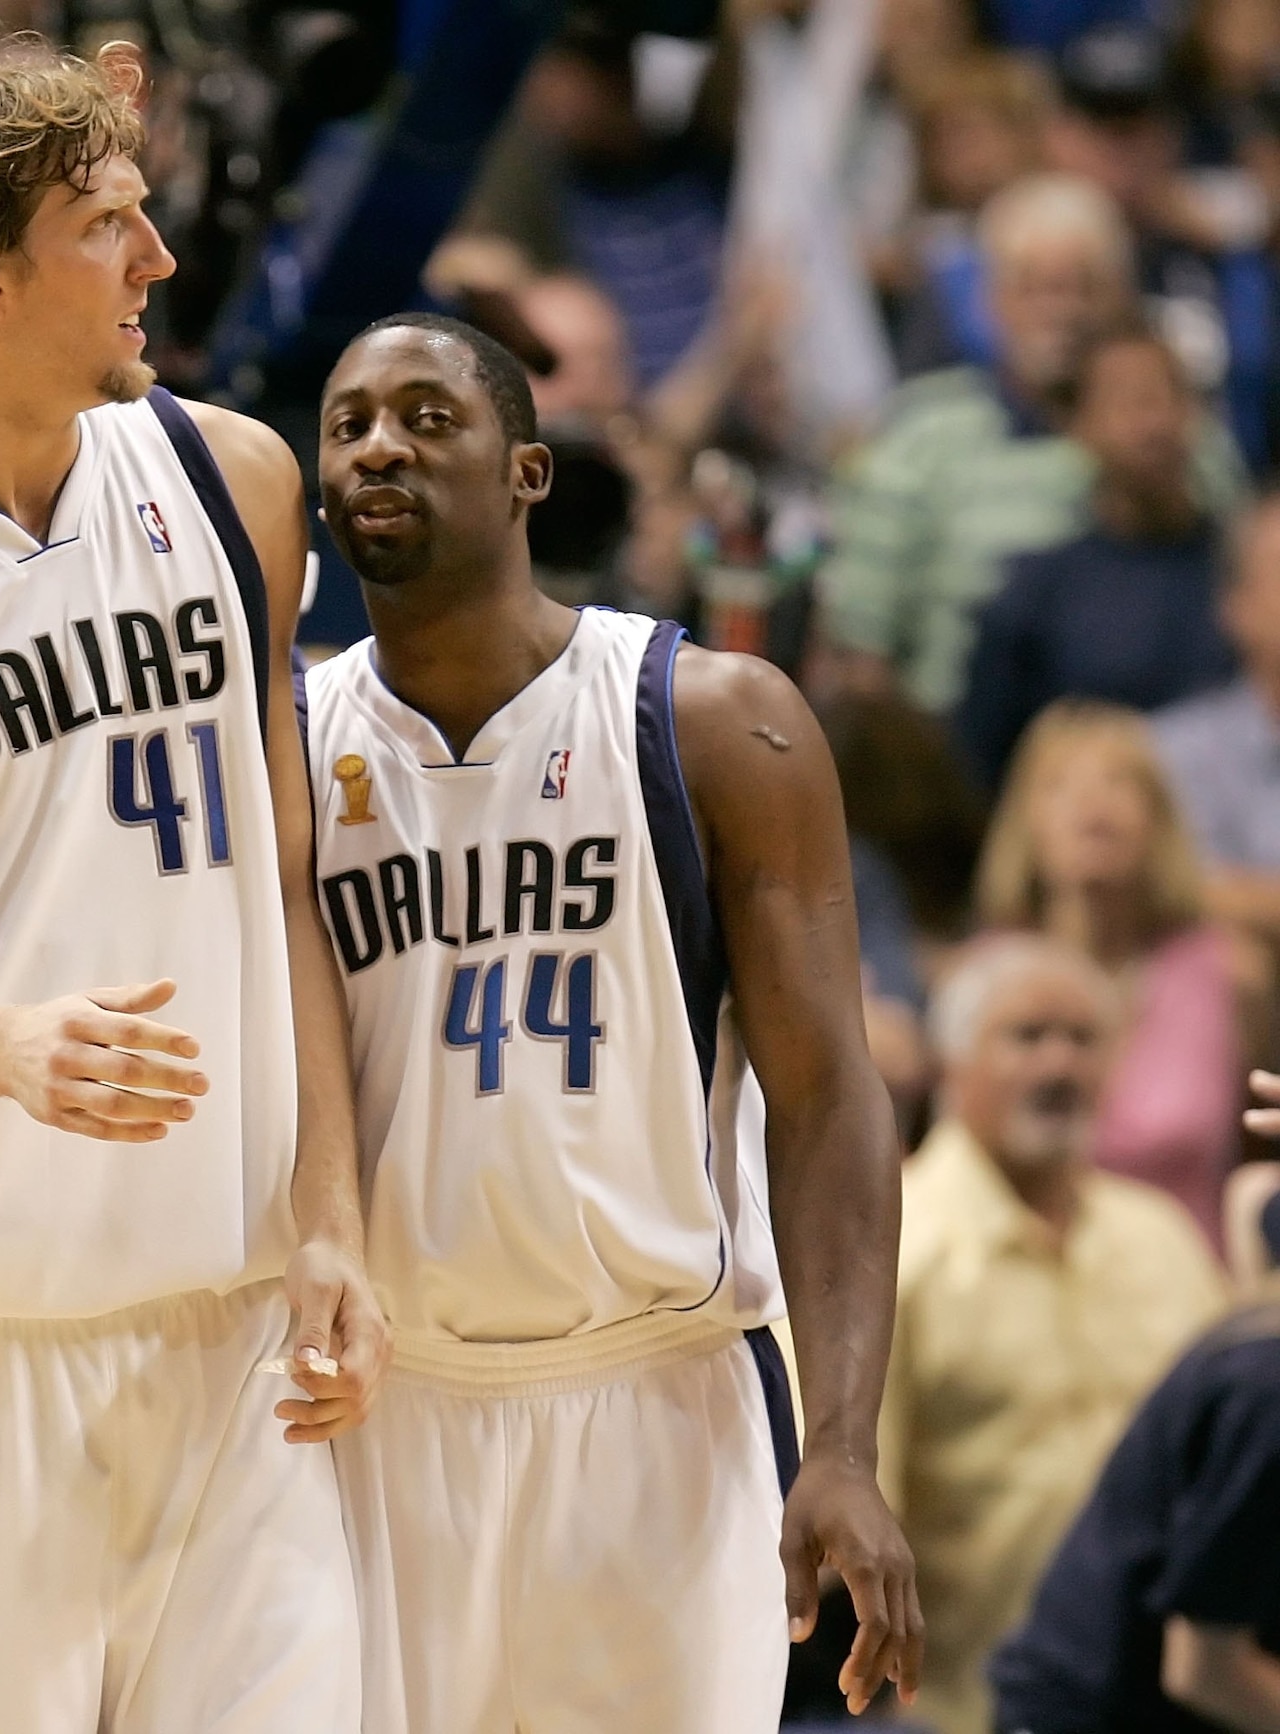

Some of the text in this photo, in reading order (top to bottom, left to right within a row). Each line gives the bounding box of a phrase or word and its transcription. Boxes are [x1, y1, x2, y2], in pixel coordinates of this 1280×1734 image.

[107, 718, 234, 877] 41
[319, 834, 620, 977] DALLAS
[441, 950, 607, 1097] 44
